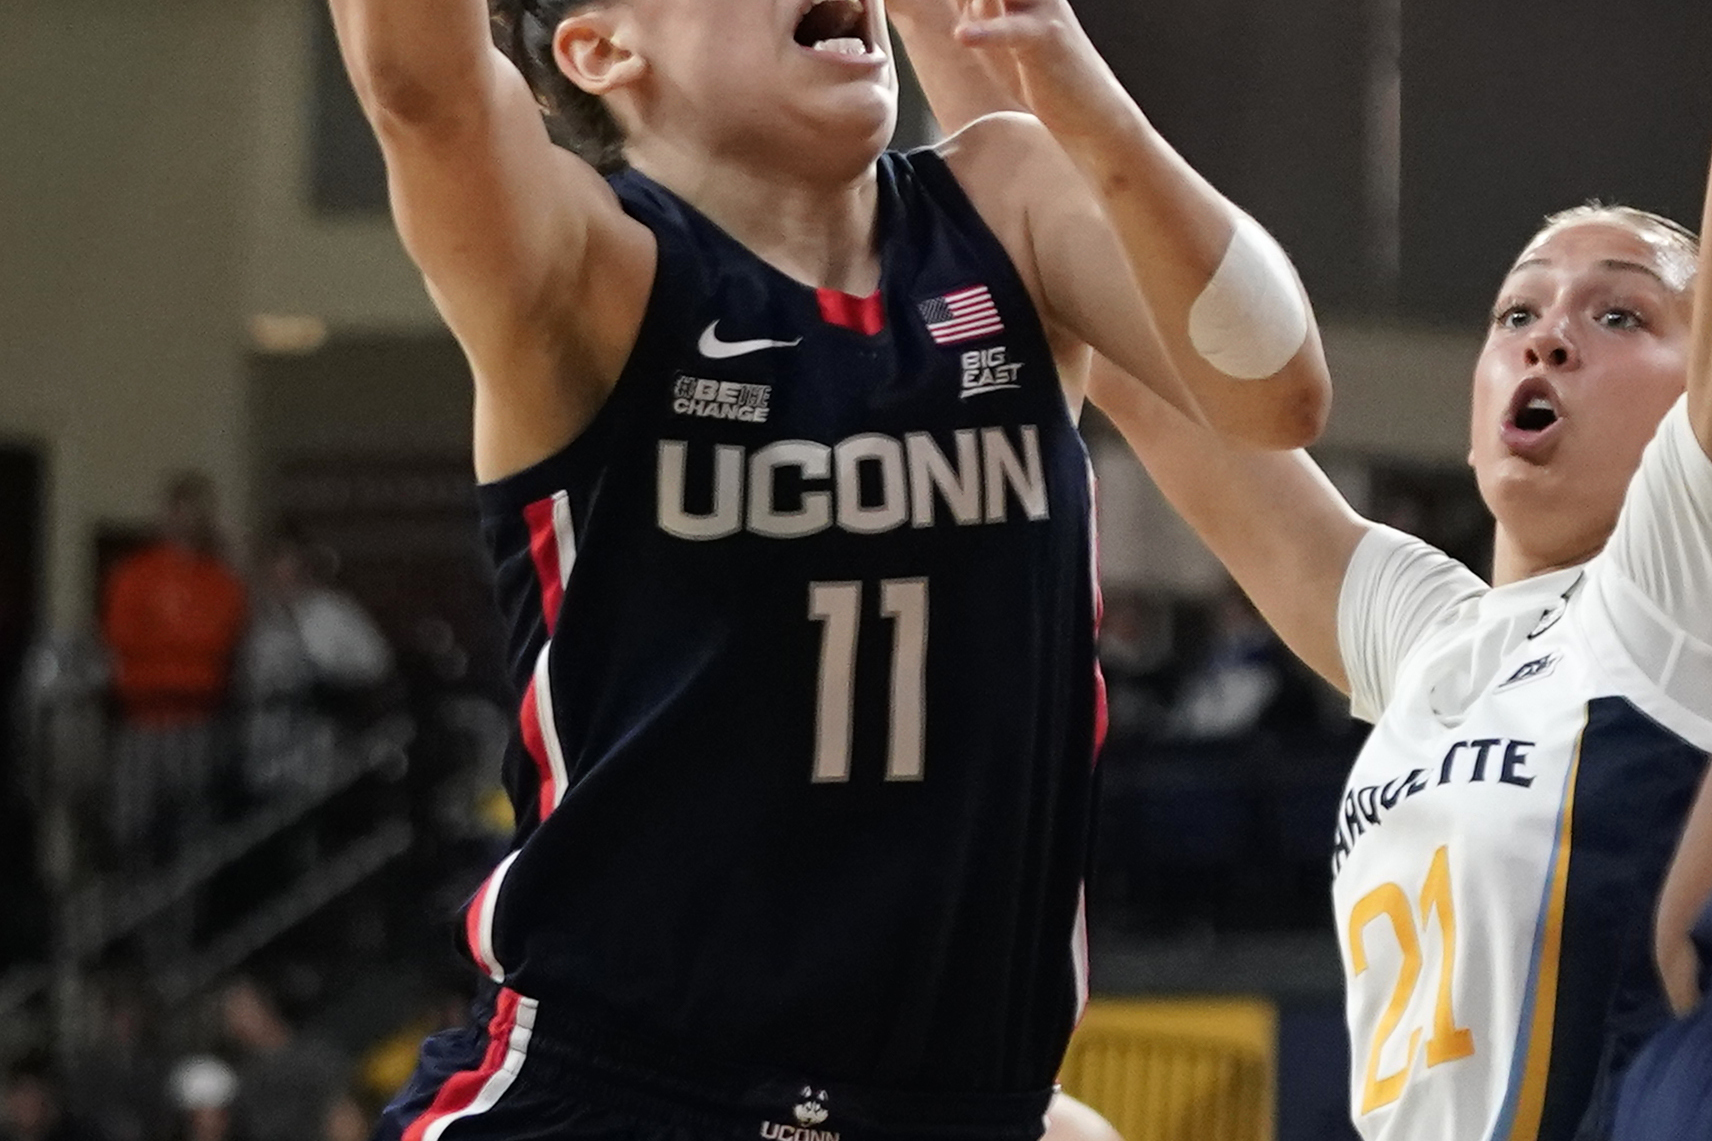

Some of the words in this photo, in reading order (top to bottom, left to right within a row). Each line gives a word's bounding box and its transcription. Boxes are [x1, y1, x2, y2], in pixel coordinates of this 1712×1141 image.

[961, 346, 1007, 370] BIG
[962, 362, 1026, 389] EAST
[673, 398, 771, 423] CHANGE
[656, 424, 1050, 542] UCONN
[807, 576, 931, 784] 11
[1332, 737, 1537, 879] ARQUETTE
[1347, 843, 1476, 1117] 21
[759, 1120, 840, 1141] UCONN
